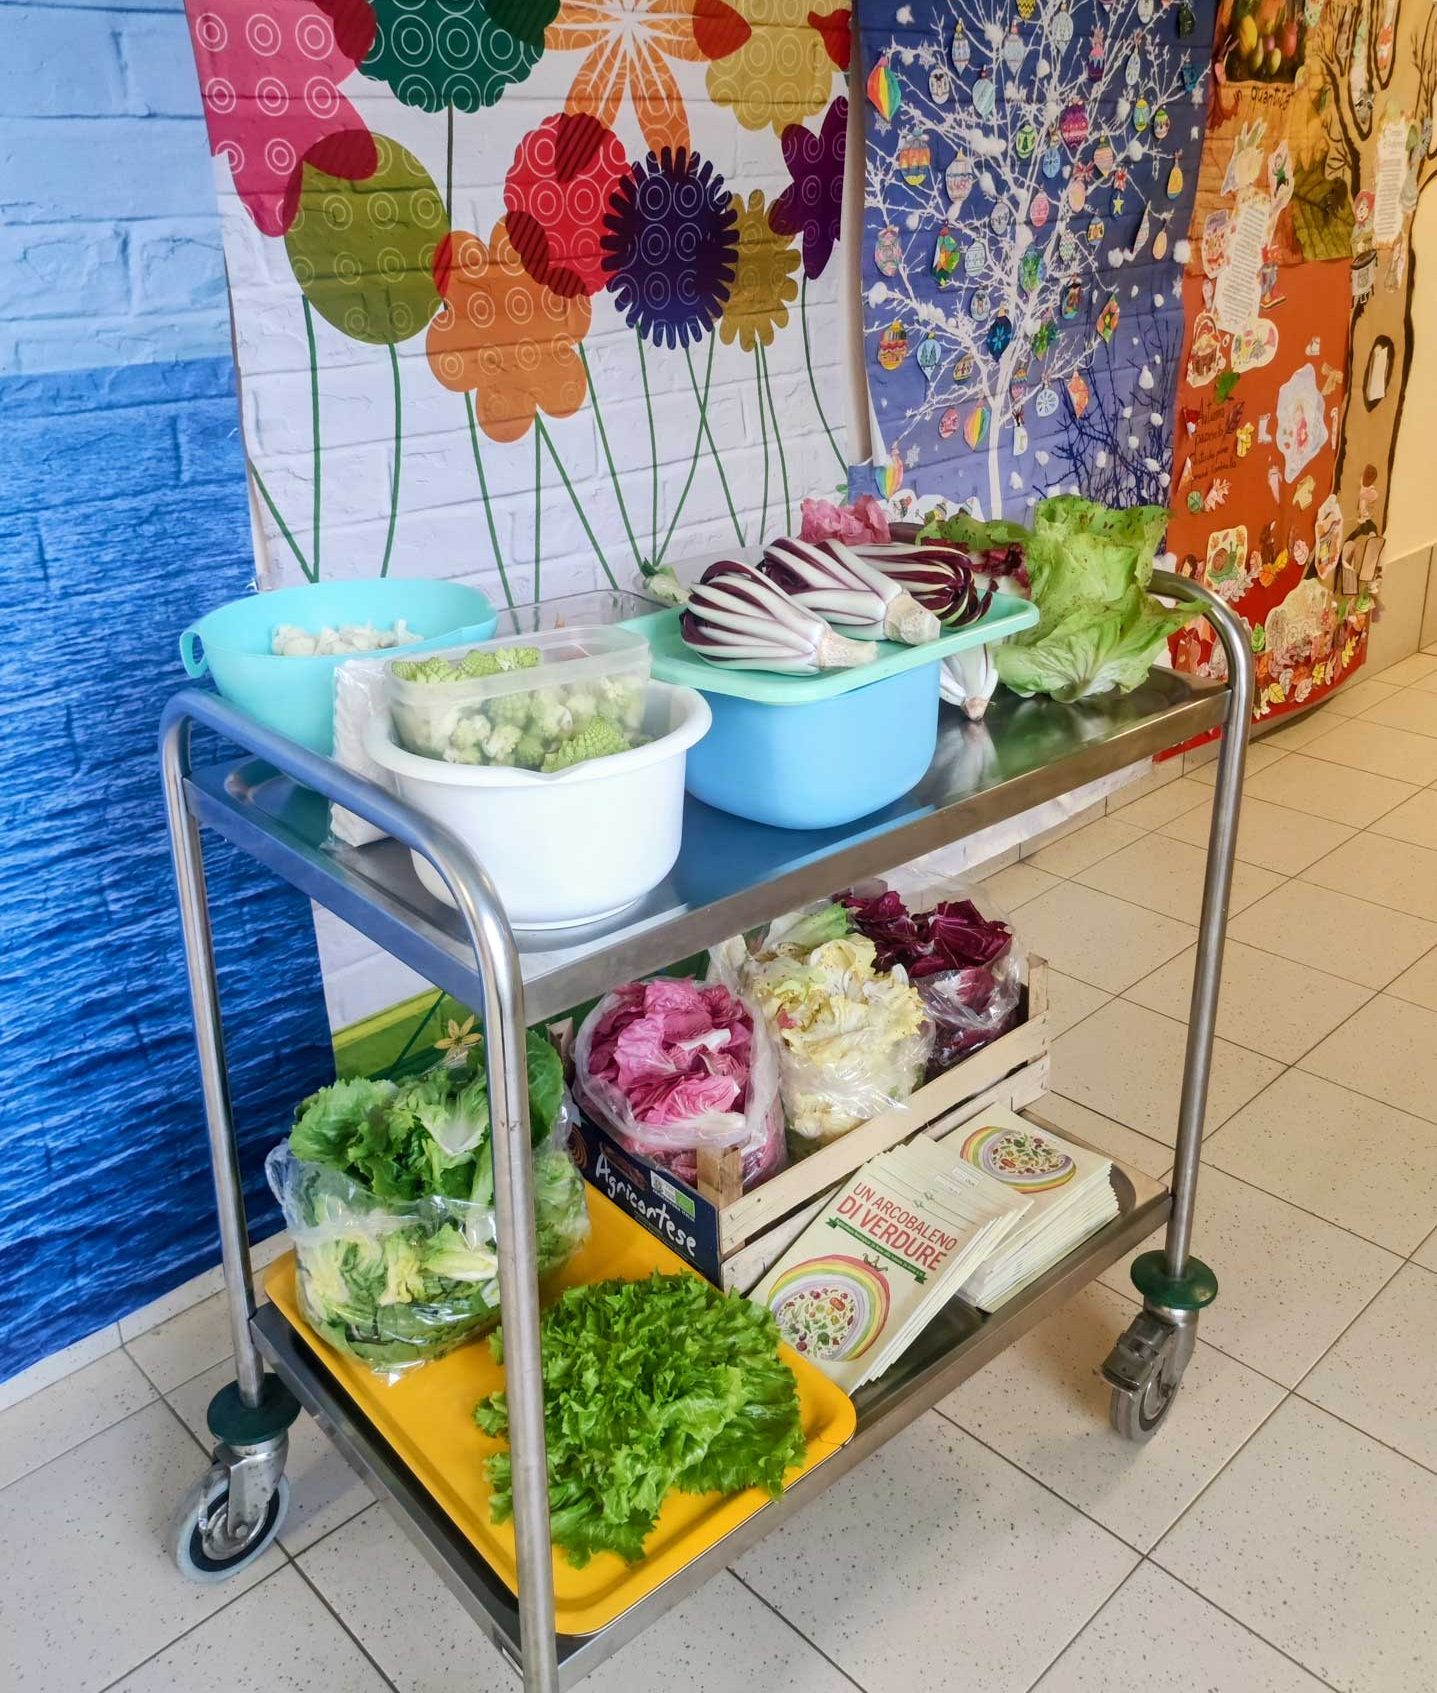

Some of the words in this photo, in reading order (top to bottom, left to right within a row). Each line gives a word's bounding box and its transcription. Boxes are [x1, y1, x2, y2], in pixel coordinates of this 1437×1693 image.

[595, 1153, 697, 1257] Agricortese
[836, 1195, 864, 1220] DI
[859, 1209, 947, 1271] VERDURE
[852, 1182, 876, 1203] UN
[871, 1196, 958, 1251] ARCOBALENO
